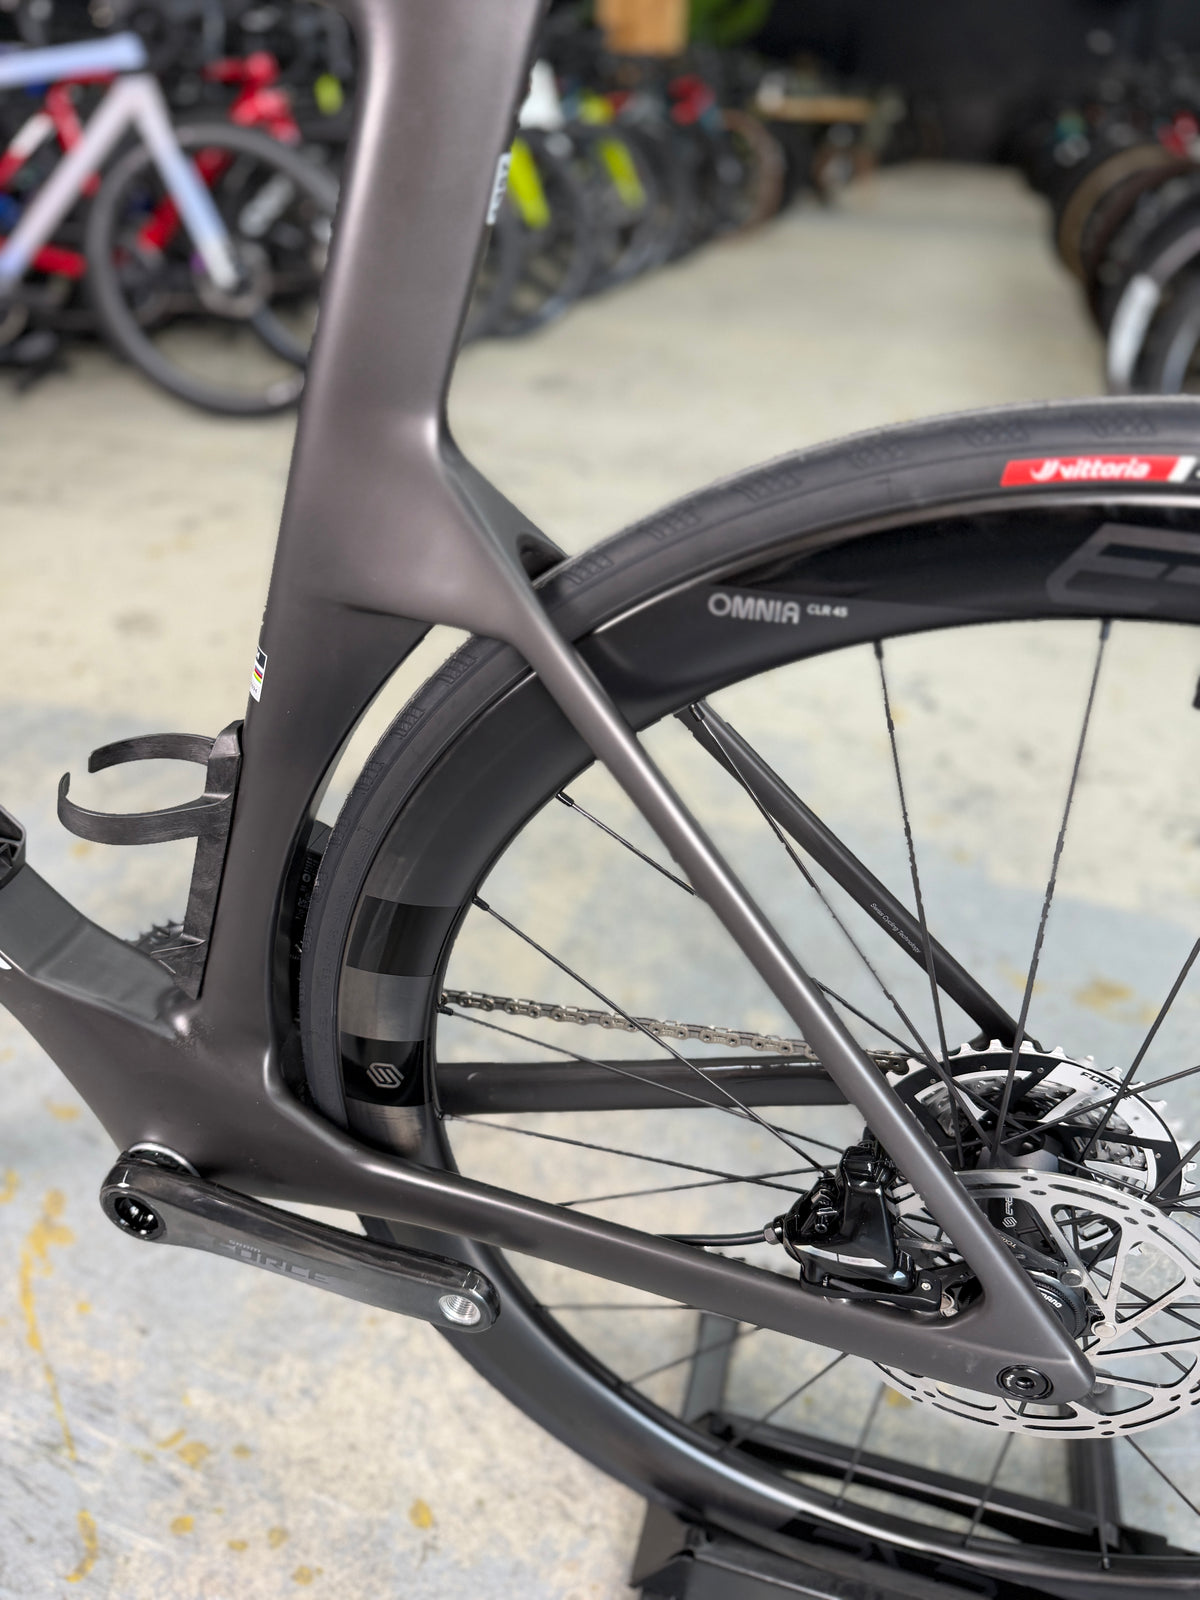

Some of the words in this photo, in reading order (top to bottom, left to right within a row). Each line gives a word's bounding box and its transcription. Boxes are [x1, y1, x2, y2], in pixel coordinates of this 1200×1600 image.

[1058, 457, 1152, 480] vittoria
[708, 592, 801, 624] OMNIA
[806, 603, 832, 617] CLR
[1080, 1071, 1127, 1098] FORC
